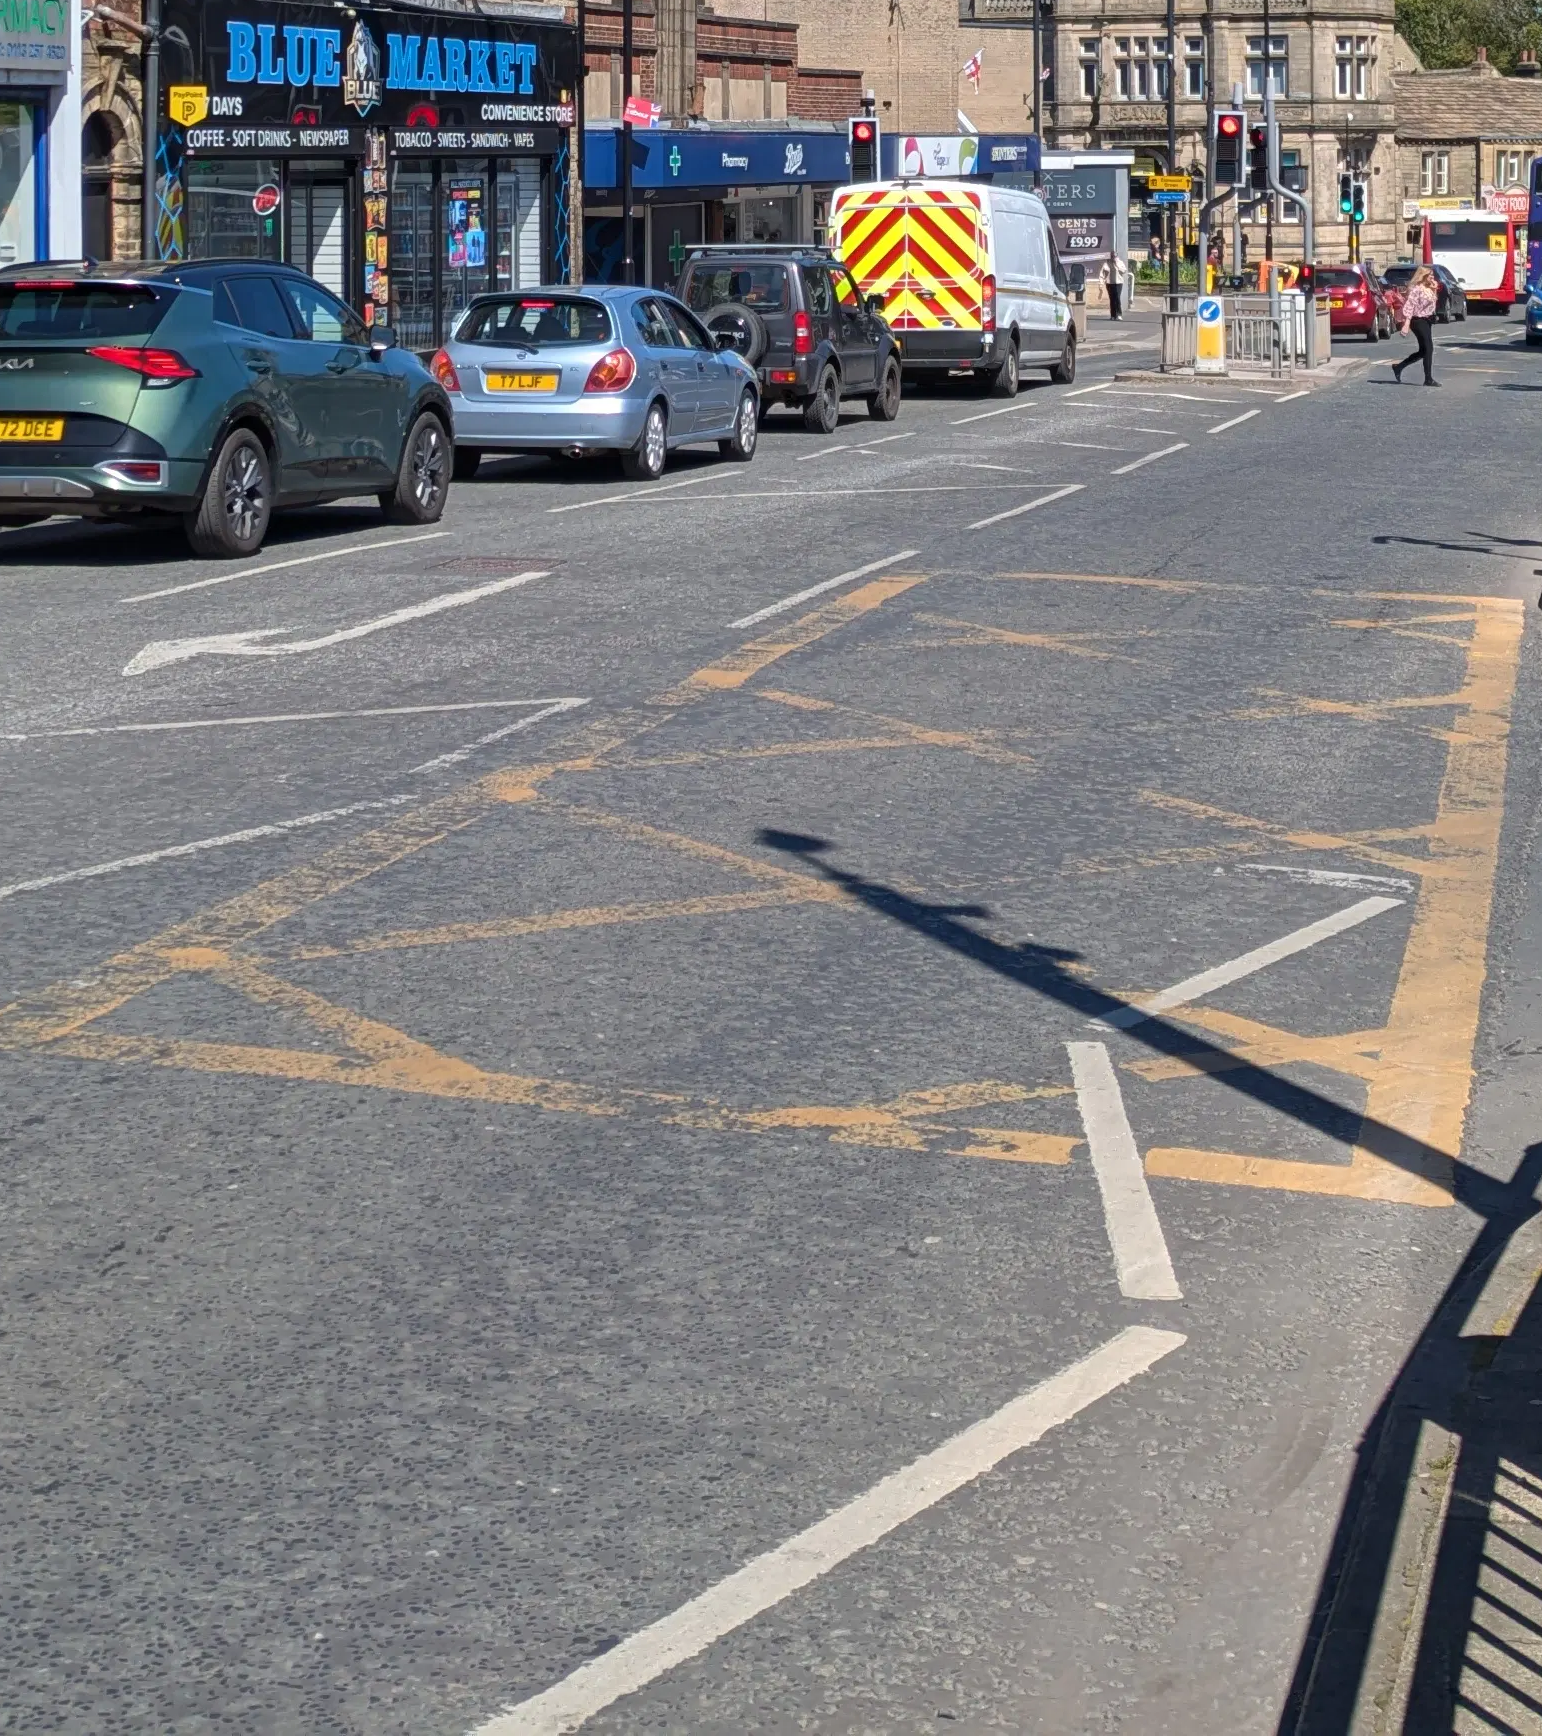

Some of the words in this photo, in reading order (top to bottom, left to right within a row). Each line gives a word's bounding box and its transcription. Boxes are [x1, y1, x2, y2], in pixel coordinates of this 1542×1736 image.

[226, 20, 341, 88] BLUE
[386, 33, 537, 95] MARKET
[173, 91, 203, 99] PayPoint
[346, 80, 381, 101] BLUE
[212, 96, 244, 116] DAYS
[480, 103, 545, 122] CONVENIENCE
[545, 105, 574, 123] STORE
[186, 129, 226, 148] COFFEE
[232, 129, 257, 147] SOFT
[258, 130, 292, 148] DRINKS
[299, 128, 350, 147] NEWSPAPER
[394, 132, 433, 148] TOBACCO
[437, 132, 467, 149] SWEETS
[471, 132, 510, 149] SANDWICH
[513, 132, 535, 148] VAPES
[722, 152, 749, 172] Pharmacy
[1510, 196, 1528, 211] FOOD
[1057, 218, 1098, 229] GENTS
[1069, 236, 1099, 248] £9.99
[500, 375, 516, 388] T7
[518, 375, 543, 388] LJF
